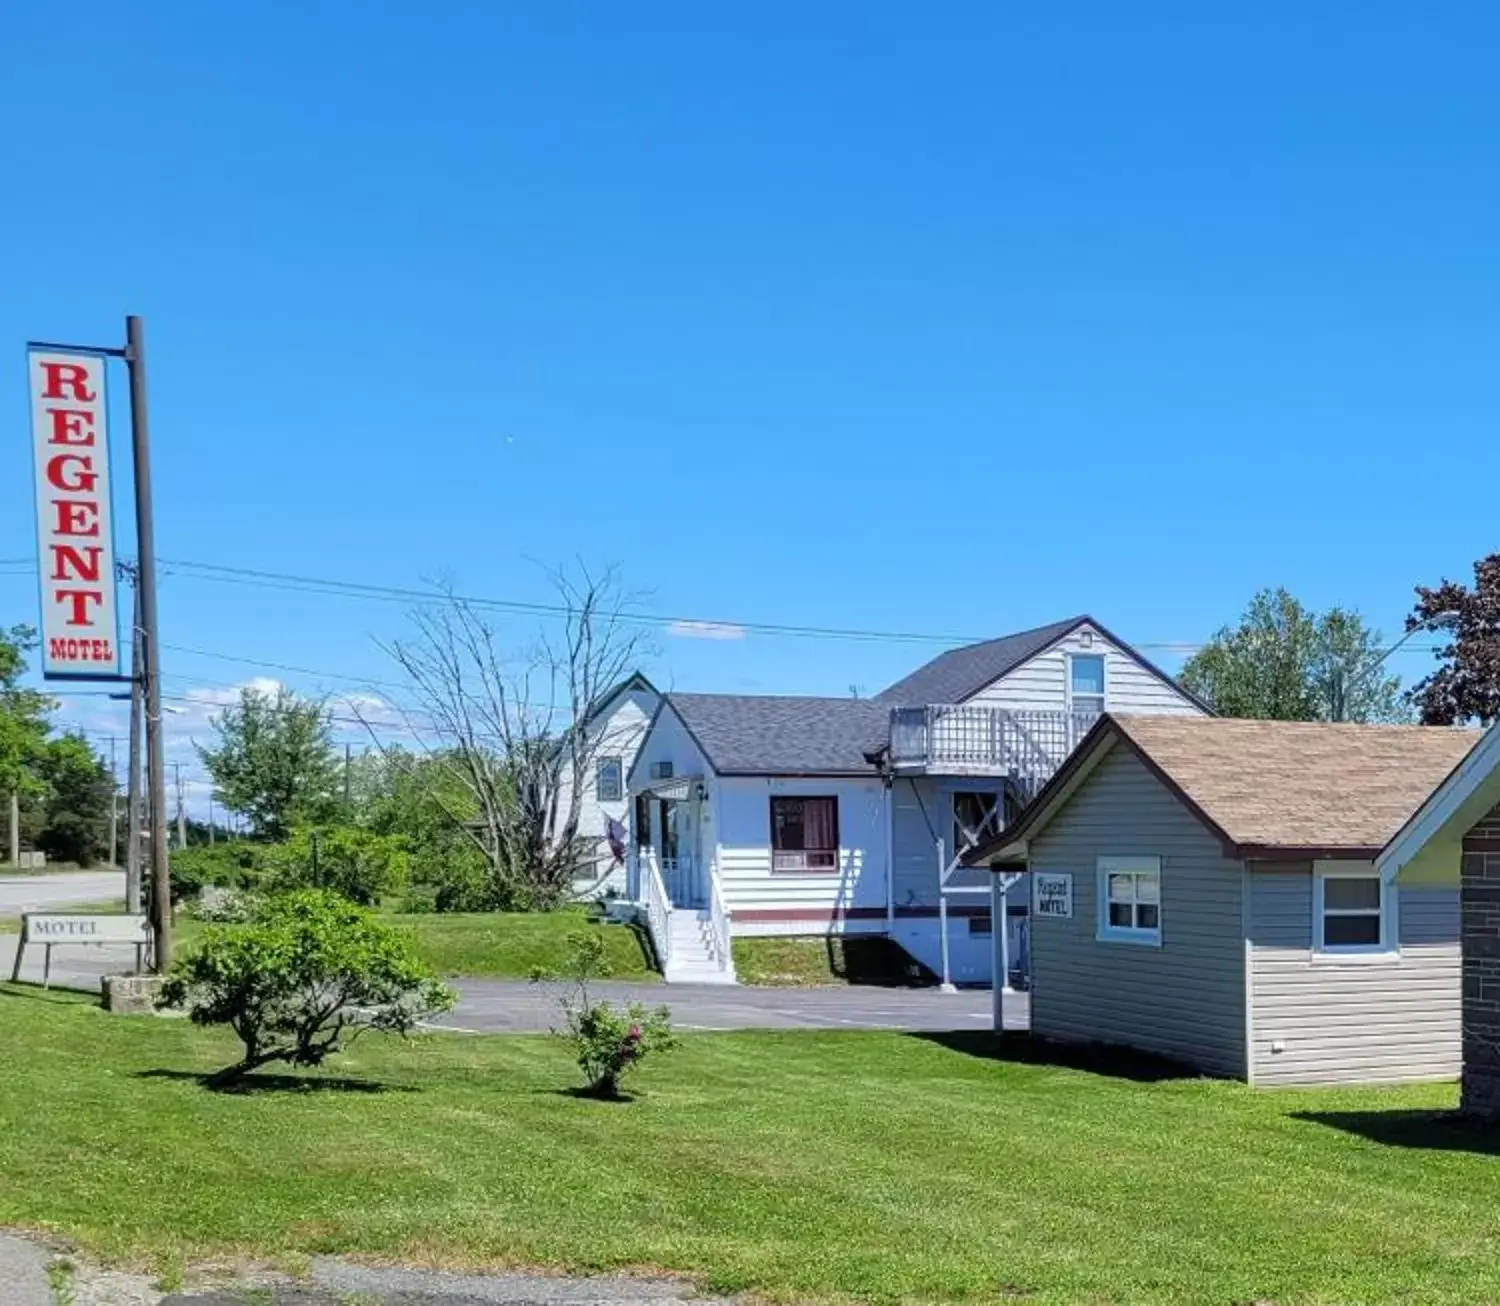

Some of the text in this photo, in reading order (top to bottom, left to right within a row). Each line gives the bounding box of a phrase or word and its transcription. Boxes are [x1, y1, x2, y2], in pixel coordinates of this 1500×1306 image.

[40, 361, 103, 626] REGENT
[50, 637, 112, 661] MOTEL
[34, 920, 97, 935] MOTEL
